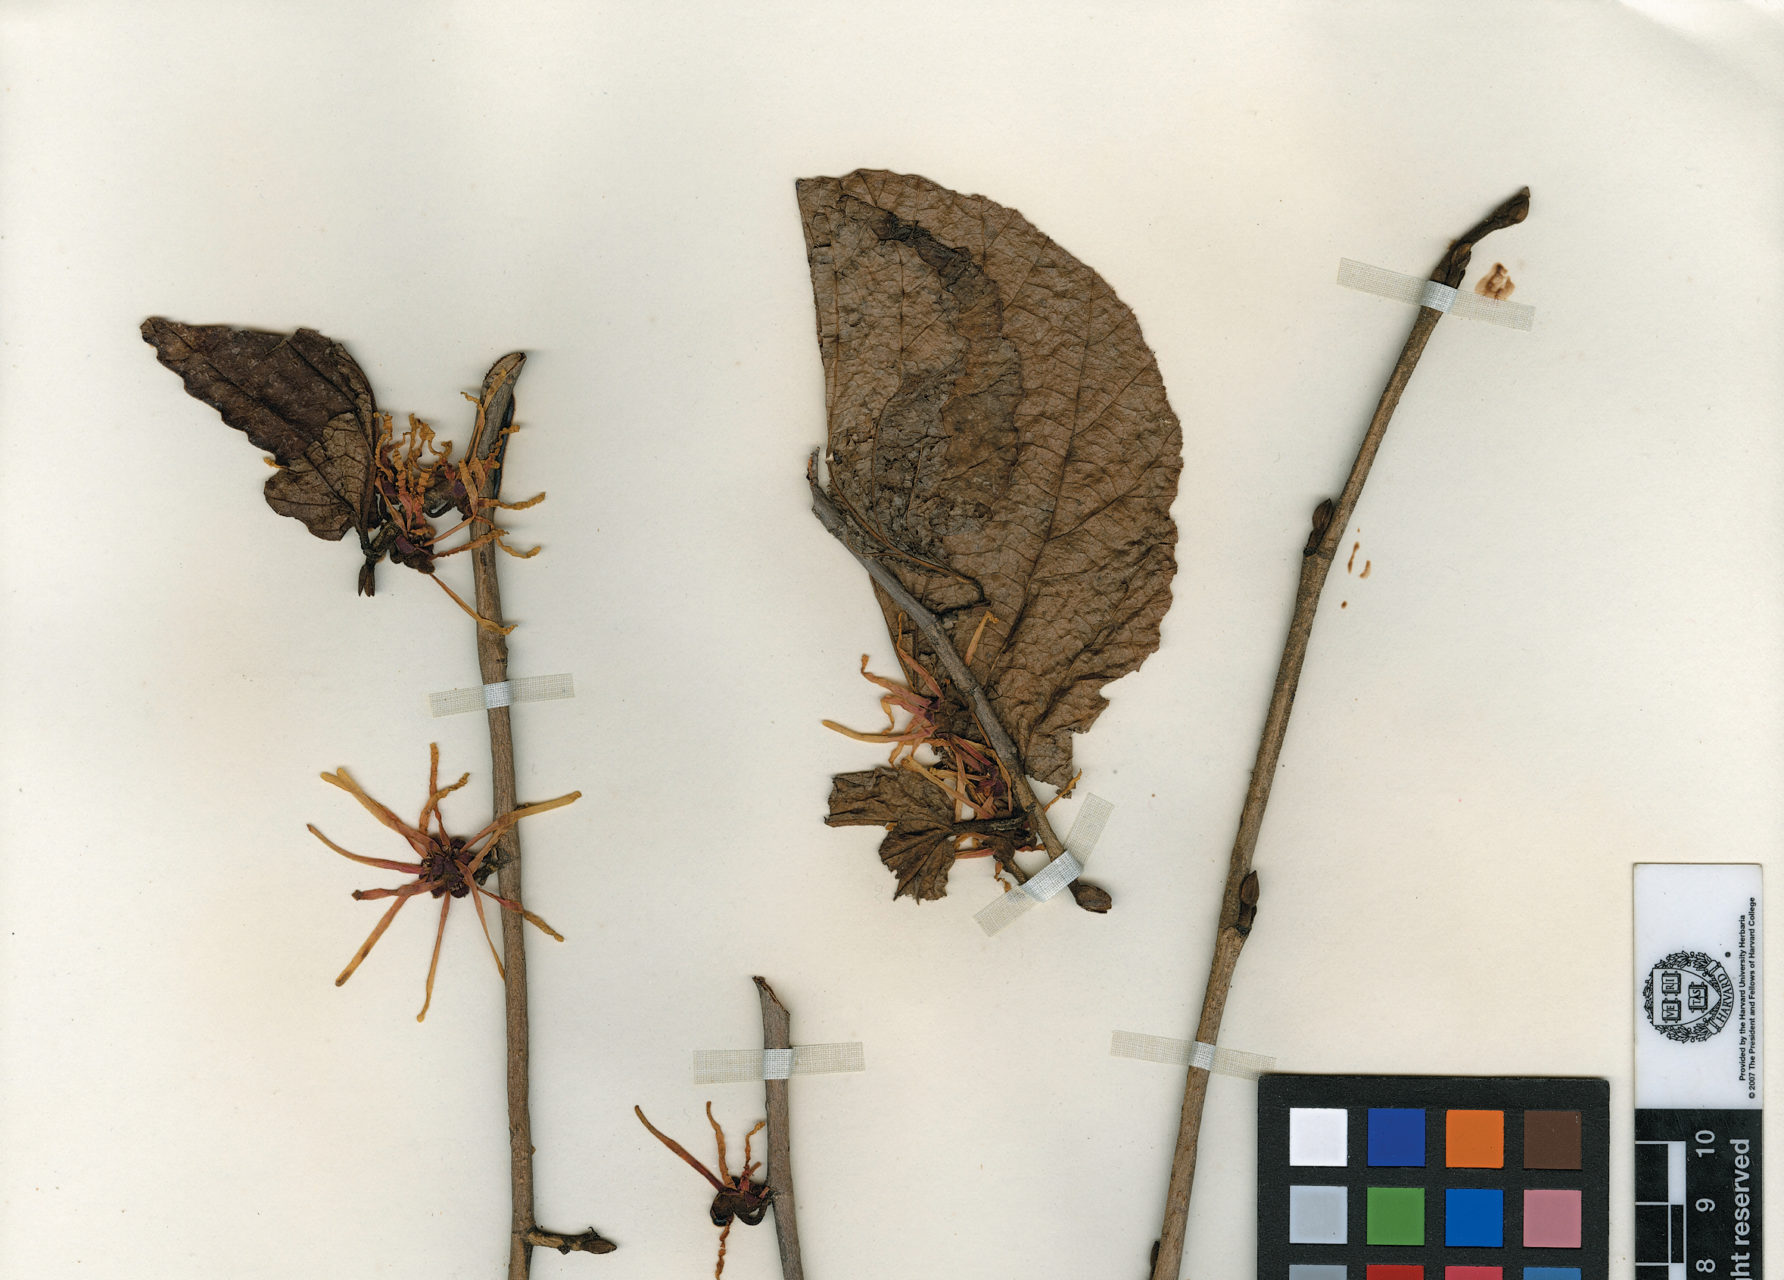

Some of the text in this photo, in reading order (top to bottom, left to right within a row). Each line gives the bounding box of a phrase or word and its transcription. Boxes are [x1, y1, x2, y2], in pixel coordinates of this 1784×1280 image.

[1748, 897, 1756, 926] College
[1739, 950, 1747, 988] University
[1716, 973, 1733, 1023] HARVARD
[1739, 1036, 1747, 1046] by
[1696, 1130, 1717, 1157] 10
[1696, 1198, 1717, 1212] 9
[1731, 1138, 1750, 1247] reserved
[1696, 1259, 1717, 1273] 8
